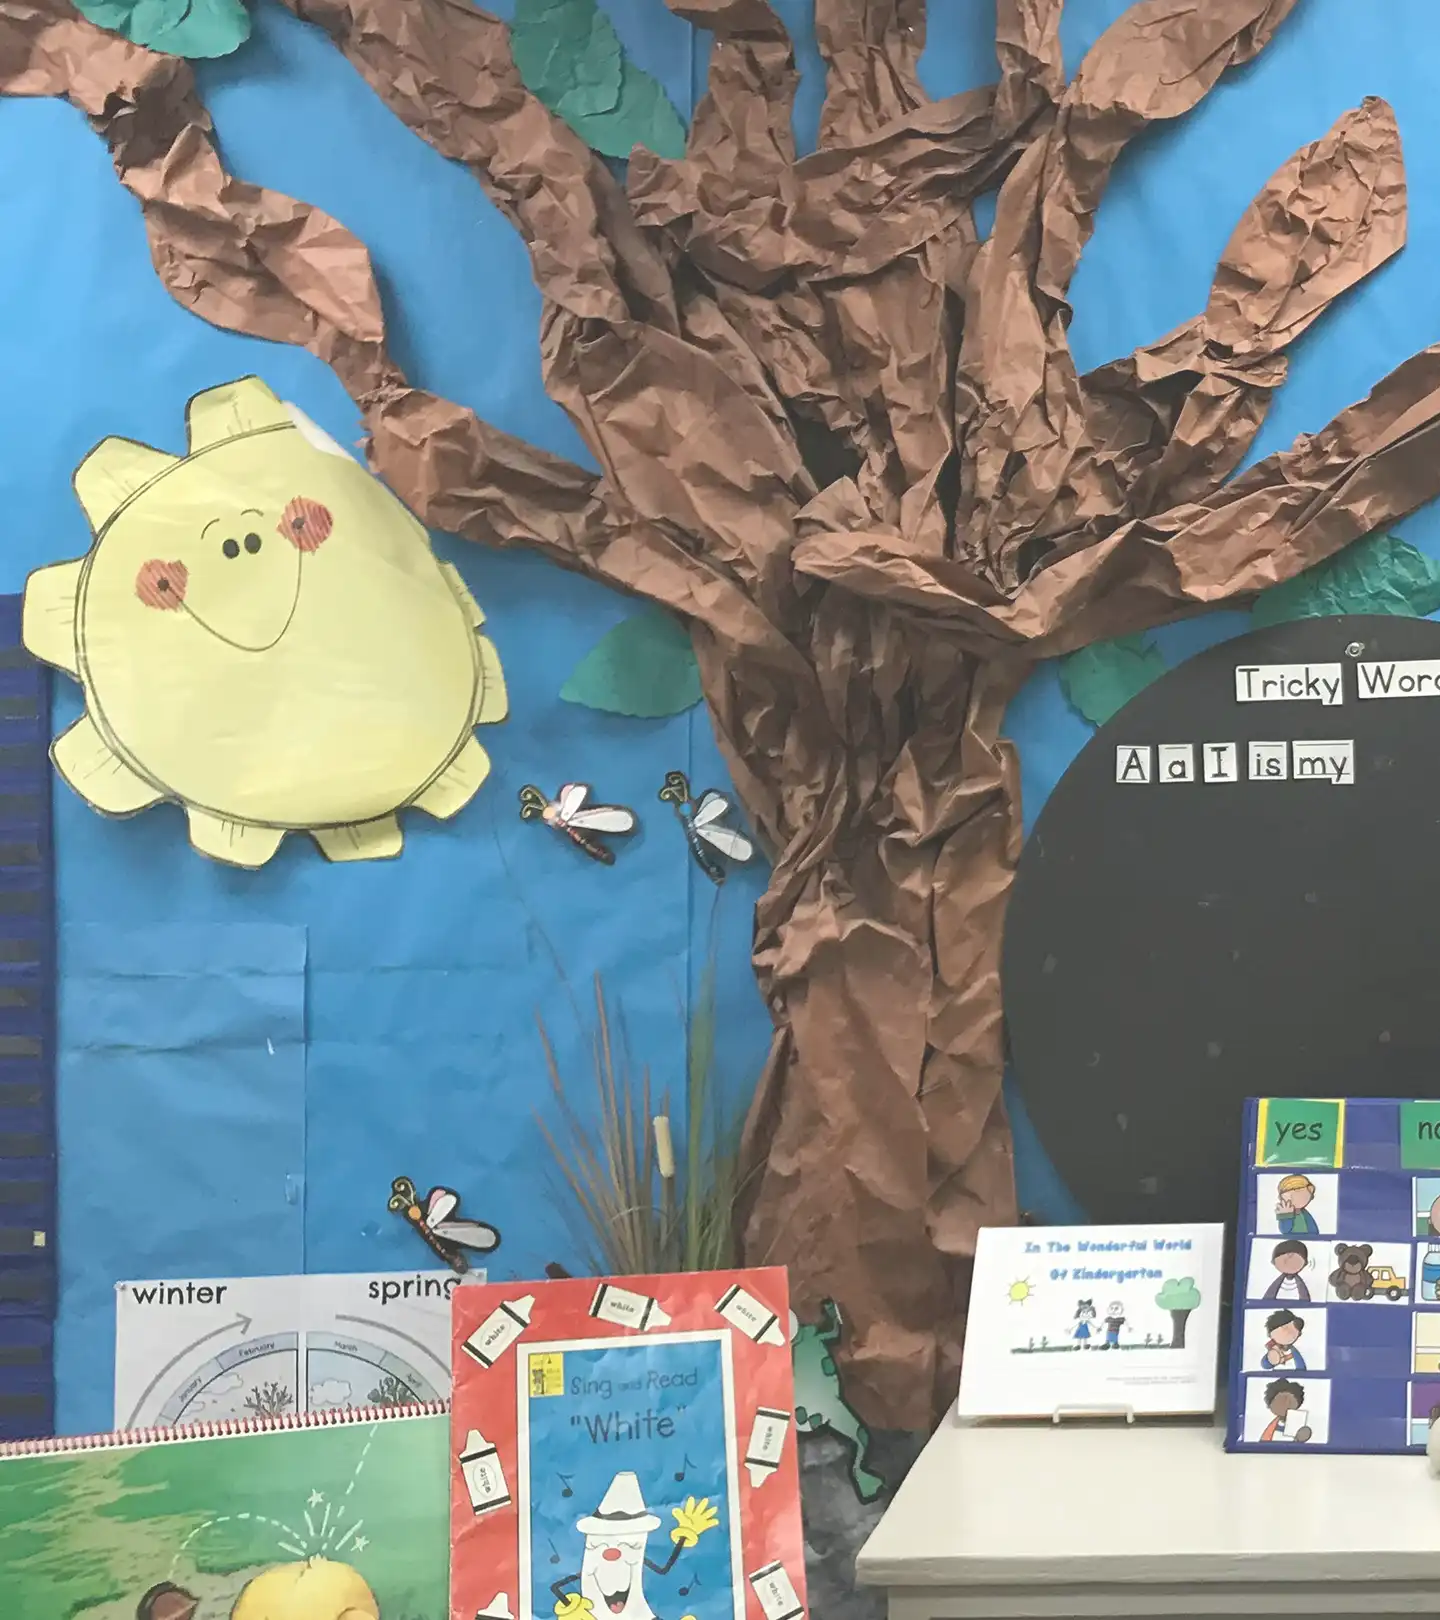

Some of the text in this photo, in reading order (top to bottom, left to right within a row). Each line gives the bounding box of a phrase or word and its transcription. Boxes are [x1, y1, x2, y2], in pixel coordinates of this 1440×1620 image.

[1238, 667, 1340, 705] Tricky
[1121, 746, 1348, 783] A a I is my
[1275, 1119, 1323, 1144] yes
[1024, 1238, 1193, 1254] In The Wonderful World
[1050, 1266, 1164, 1284] Of Kindergarten
[132, 1282, 228, 1305] winter
[368, 1274, 462, 1305] spring
[610, 1301, 635, 1314] white
[736, 1304, 757, 1322] white
[485, 1324, 505, 1346] white
[571, 1376, 612, 1400] Sing
[647, 1367, 698, 1390] Read
[570, 1404, 688, 1444] "White"
[762, 1426, 773, 1451] white
[480, 1467, 491, 1494] white
